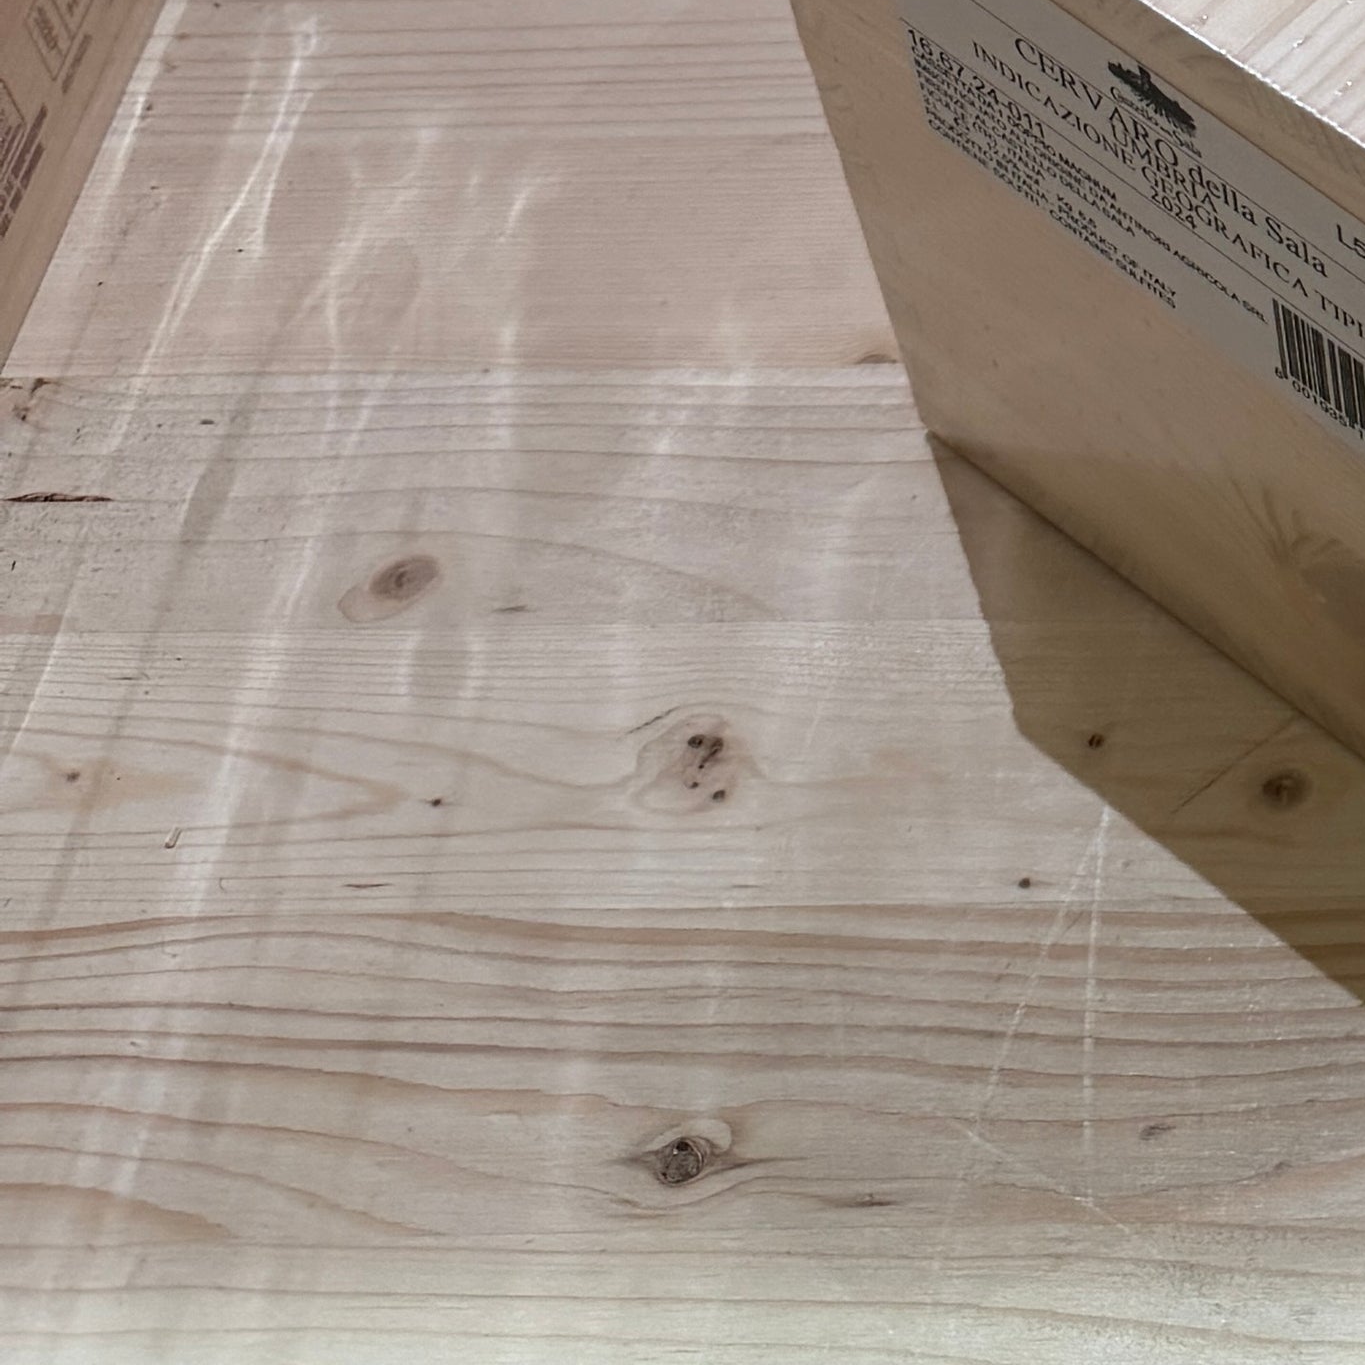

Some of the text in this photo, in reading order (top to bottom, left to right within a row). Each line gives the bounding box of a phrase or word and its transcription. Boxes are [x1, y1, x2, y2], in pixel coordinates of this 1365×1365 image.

[971, 39, 1137, 174] INDICAZIONE
[1139, 160, 1309, 299] GEOGRAFICA
[1012, 31, 1180, 172] CERVARO
[1185, 156, 1257, 228] della
[1263, 212, 1328, 279] Sala
[1110, 122, 1218, 215] UMBRIA
[1148, 183, 1198, 233] 2024
